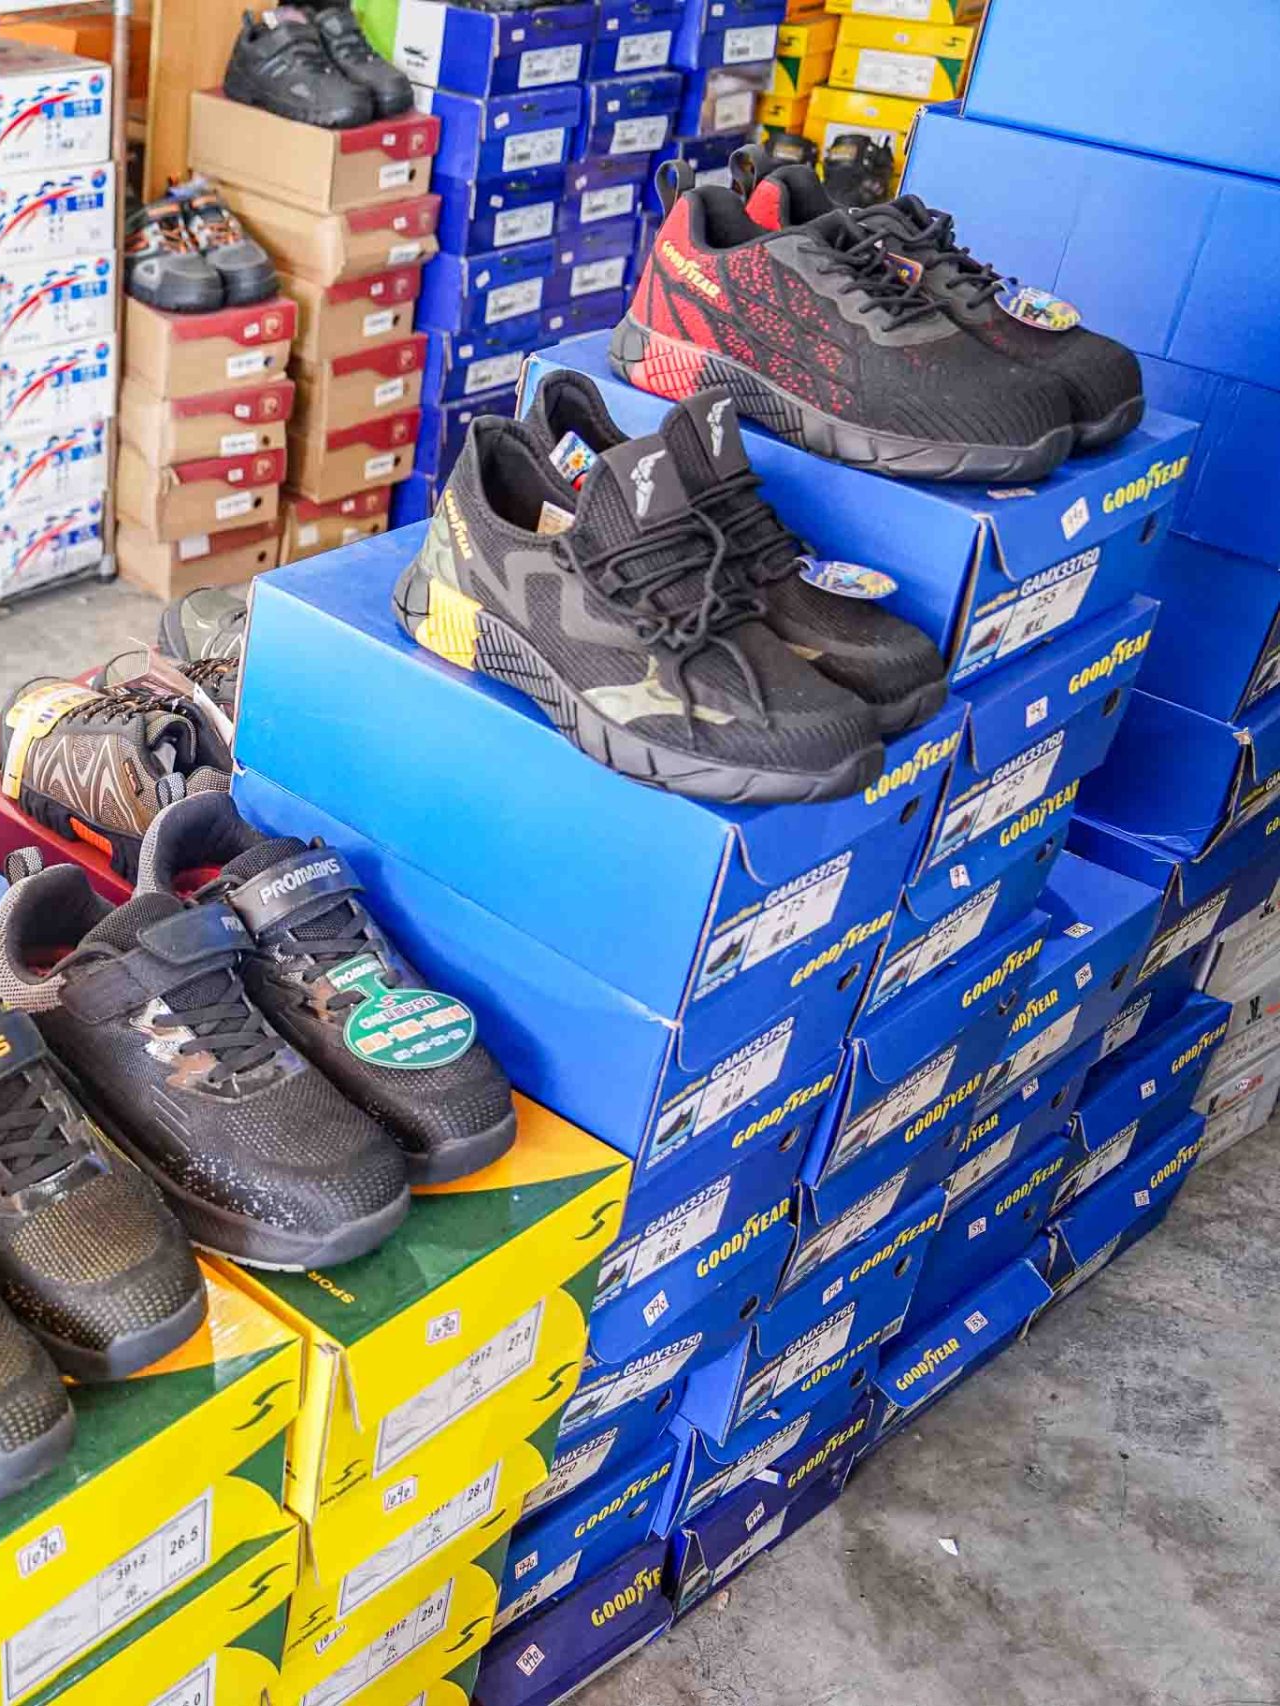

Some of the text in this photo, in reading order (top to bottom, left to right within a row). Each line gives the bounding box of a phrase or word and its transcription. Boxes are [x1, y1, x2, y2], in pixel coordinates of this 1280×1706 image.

[660, 239, 721, 299] GOODYEAR
[1103, 457, 1188, 513] GOODYEAR
[1069, 631, 1151, 694] GOODYEAR
[1000, 778, 1079, 847] GOODYEAR
[259, 858, 341, 905] PROMARKS
[790, 911, 892, 987] GOODYEAR
[962, 938, 1043, 1007] GOODYEAR
[1009, 989, 1059, 1037] ODYEAR
[1171, 1025, 1227, 1073] GOODYEAR
[731, 1073, 833, 1148] GOODYEAR
[904, 1071, 982, 1144] GOODYEAR
[959, 1114, 999, 1152] YEAR
[995, 1157, 1064, 1216] GOODYEAR
[1150, 1134, 1205, 1189] GOODYEAR
[645, 1175, 731, 1236] GAMX33750
[696, 1198, 791, 1278] GOODYEAR
[849, 1212, 939, 1282] GOODYEAR
[308, 1270, 355, 1304] SPOR
[507, 1326, 531, 1352] 27.0
[623, 1332, 703, 1376] GAMX33750
[896, 1338, 959, 1391] GOODYEAR
[551, 1427, 618, 1472] AMX33750
[788, 1417, 865, 1489] GOODYEAR
[467, 1477, 490, 1502] 28.0
[574, 1462, 671, 1538] GOODYEAR
[170, 1526, 198, 1556] 26.5
[421, 1599, 443, 1622] 29.0
[591, 1566, 662, 1628] GOODYE
[522, 1651, 539, 1668] 990
